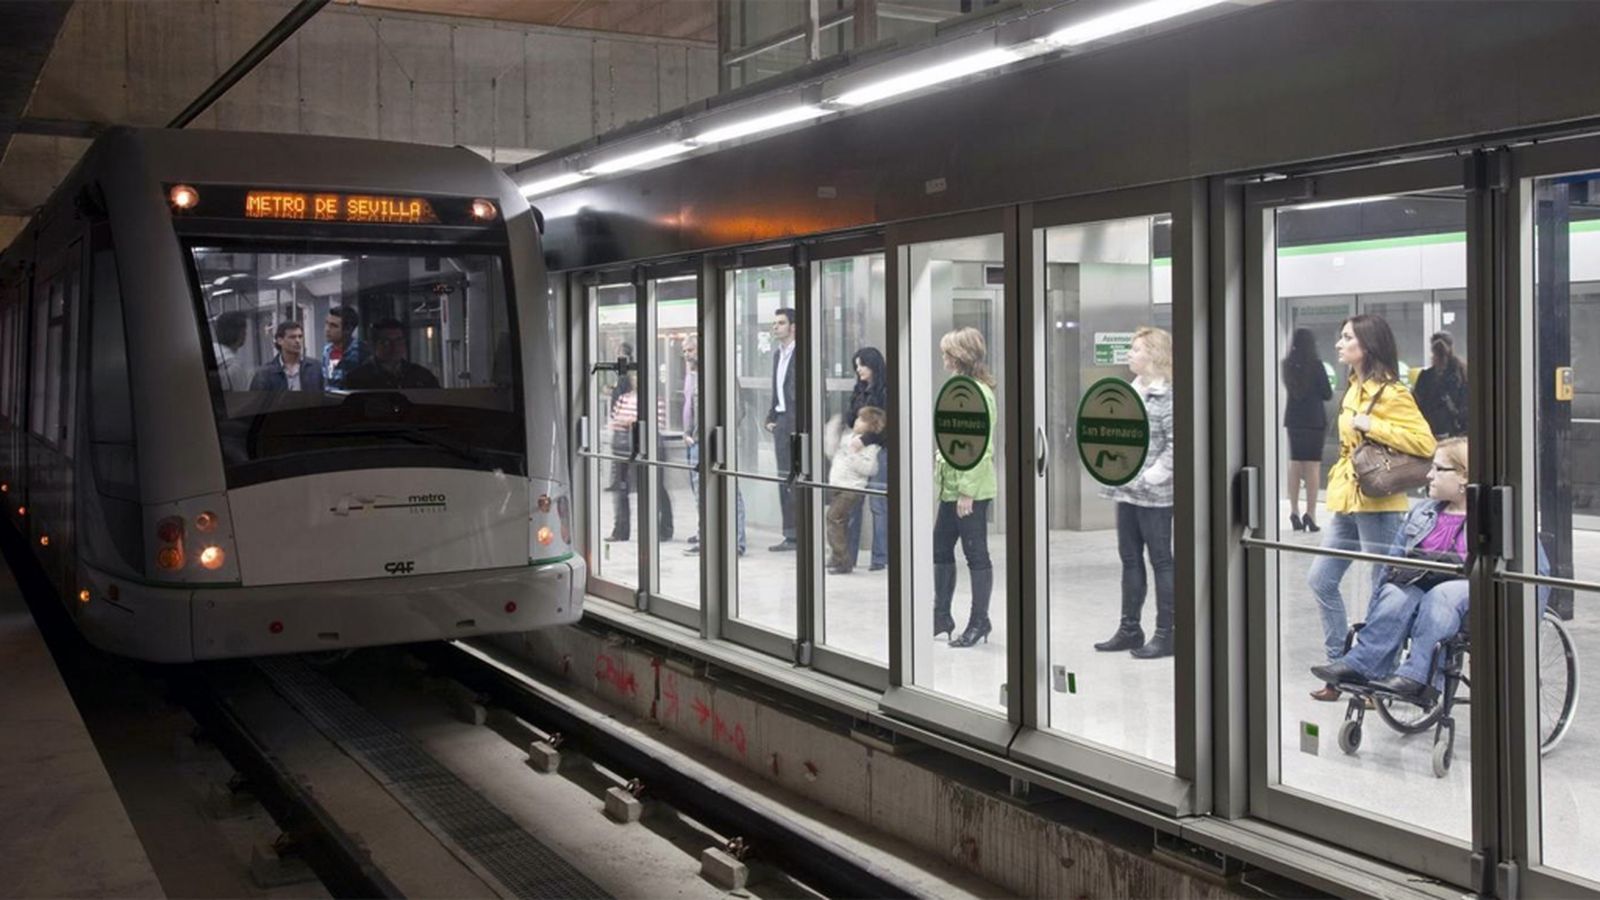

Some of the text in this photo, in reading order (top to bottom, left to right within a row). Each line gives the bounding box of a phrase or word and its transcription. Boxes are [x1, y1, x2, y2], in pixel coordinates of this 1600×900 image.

[246, 196, 421, 215] METRO DE SEVILLA
[408, 493, 446, 502] metro
[384, 561, 415, 574] CAF
